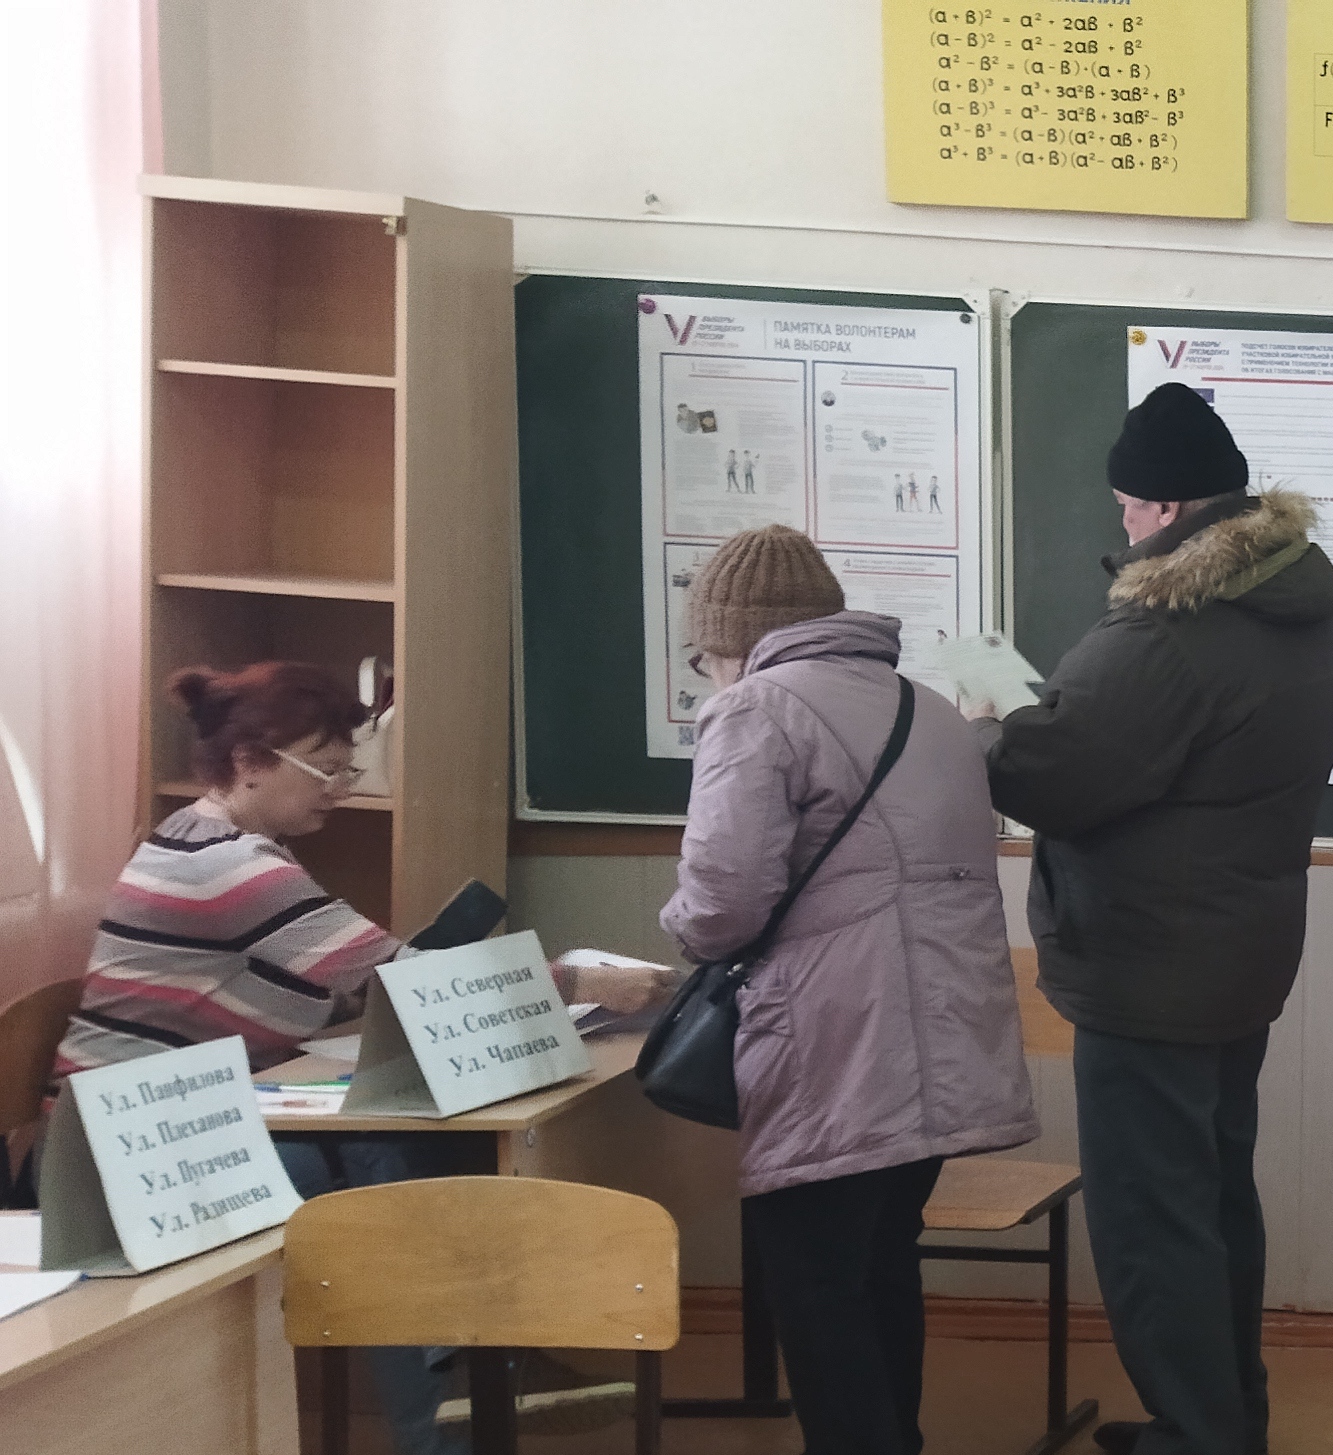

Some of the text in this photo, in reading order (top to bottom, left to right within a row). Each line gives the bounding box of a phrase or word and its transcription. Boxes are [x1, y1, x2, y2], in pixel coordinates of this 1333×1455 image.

[774, 321, 917, 339] ПАМЯТКА ВОЛОНТЕРАМ
[774, 339, 851, 351] НА ВЫБОРАХ
[411, 967, 533, 1007] Ул. Северная
[424, 999, 551, 1044] Ул. Советская
[449, 1035, 560, 1077] Ул. Чапаева
[100, 1066, 234, 1115] Ул. Панфилова
[118, 1107, 243, 1156] Ул. Плеханова
[140, 1147, 251, 1195] Ул. Пугачева
[150, 1185, 272, 1238] Ул. Радищева
